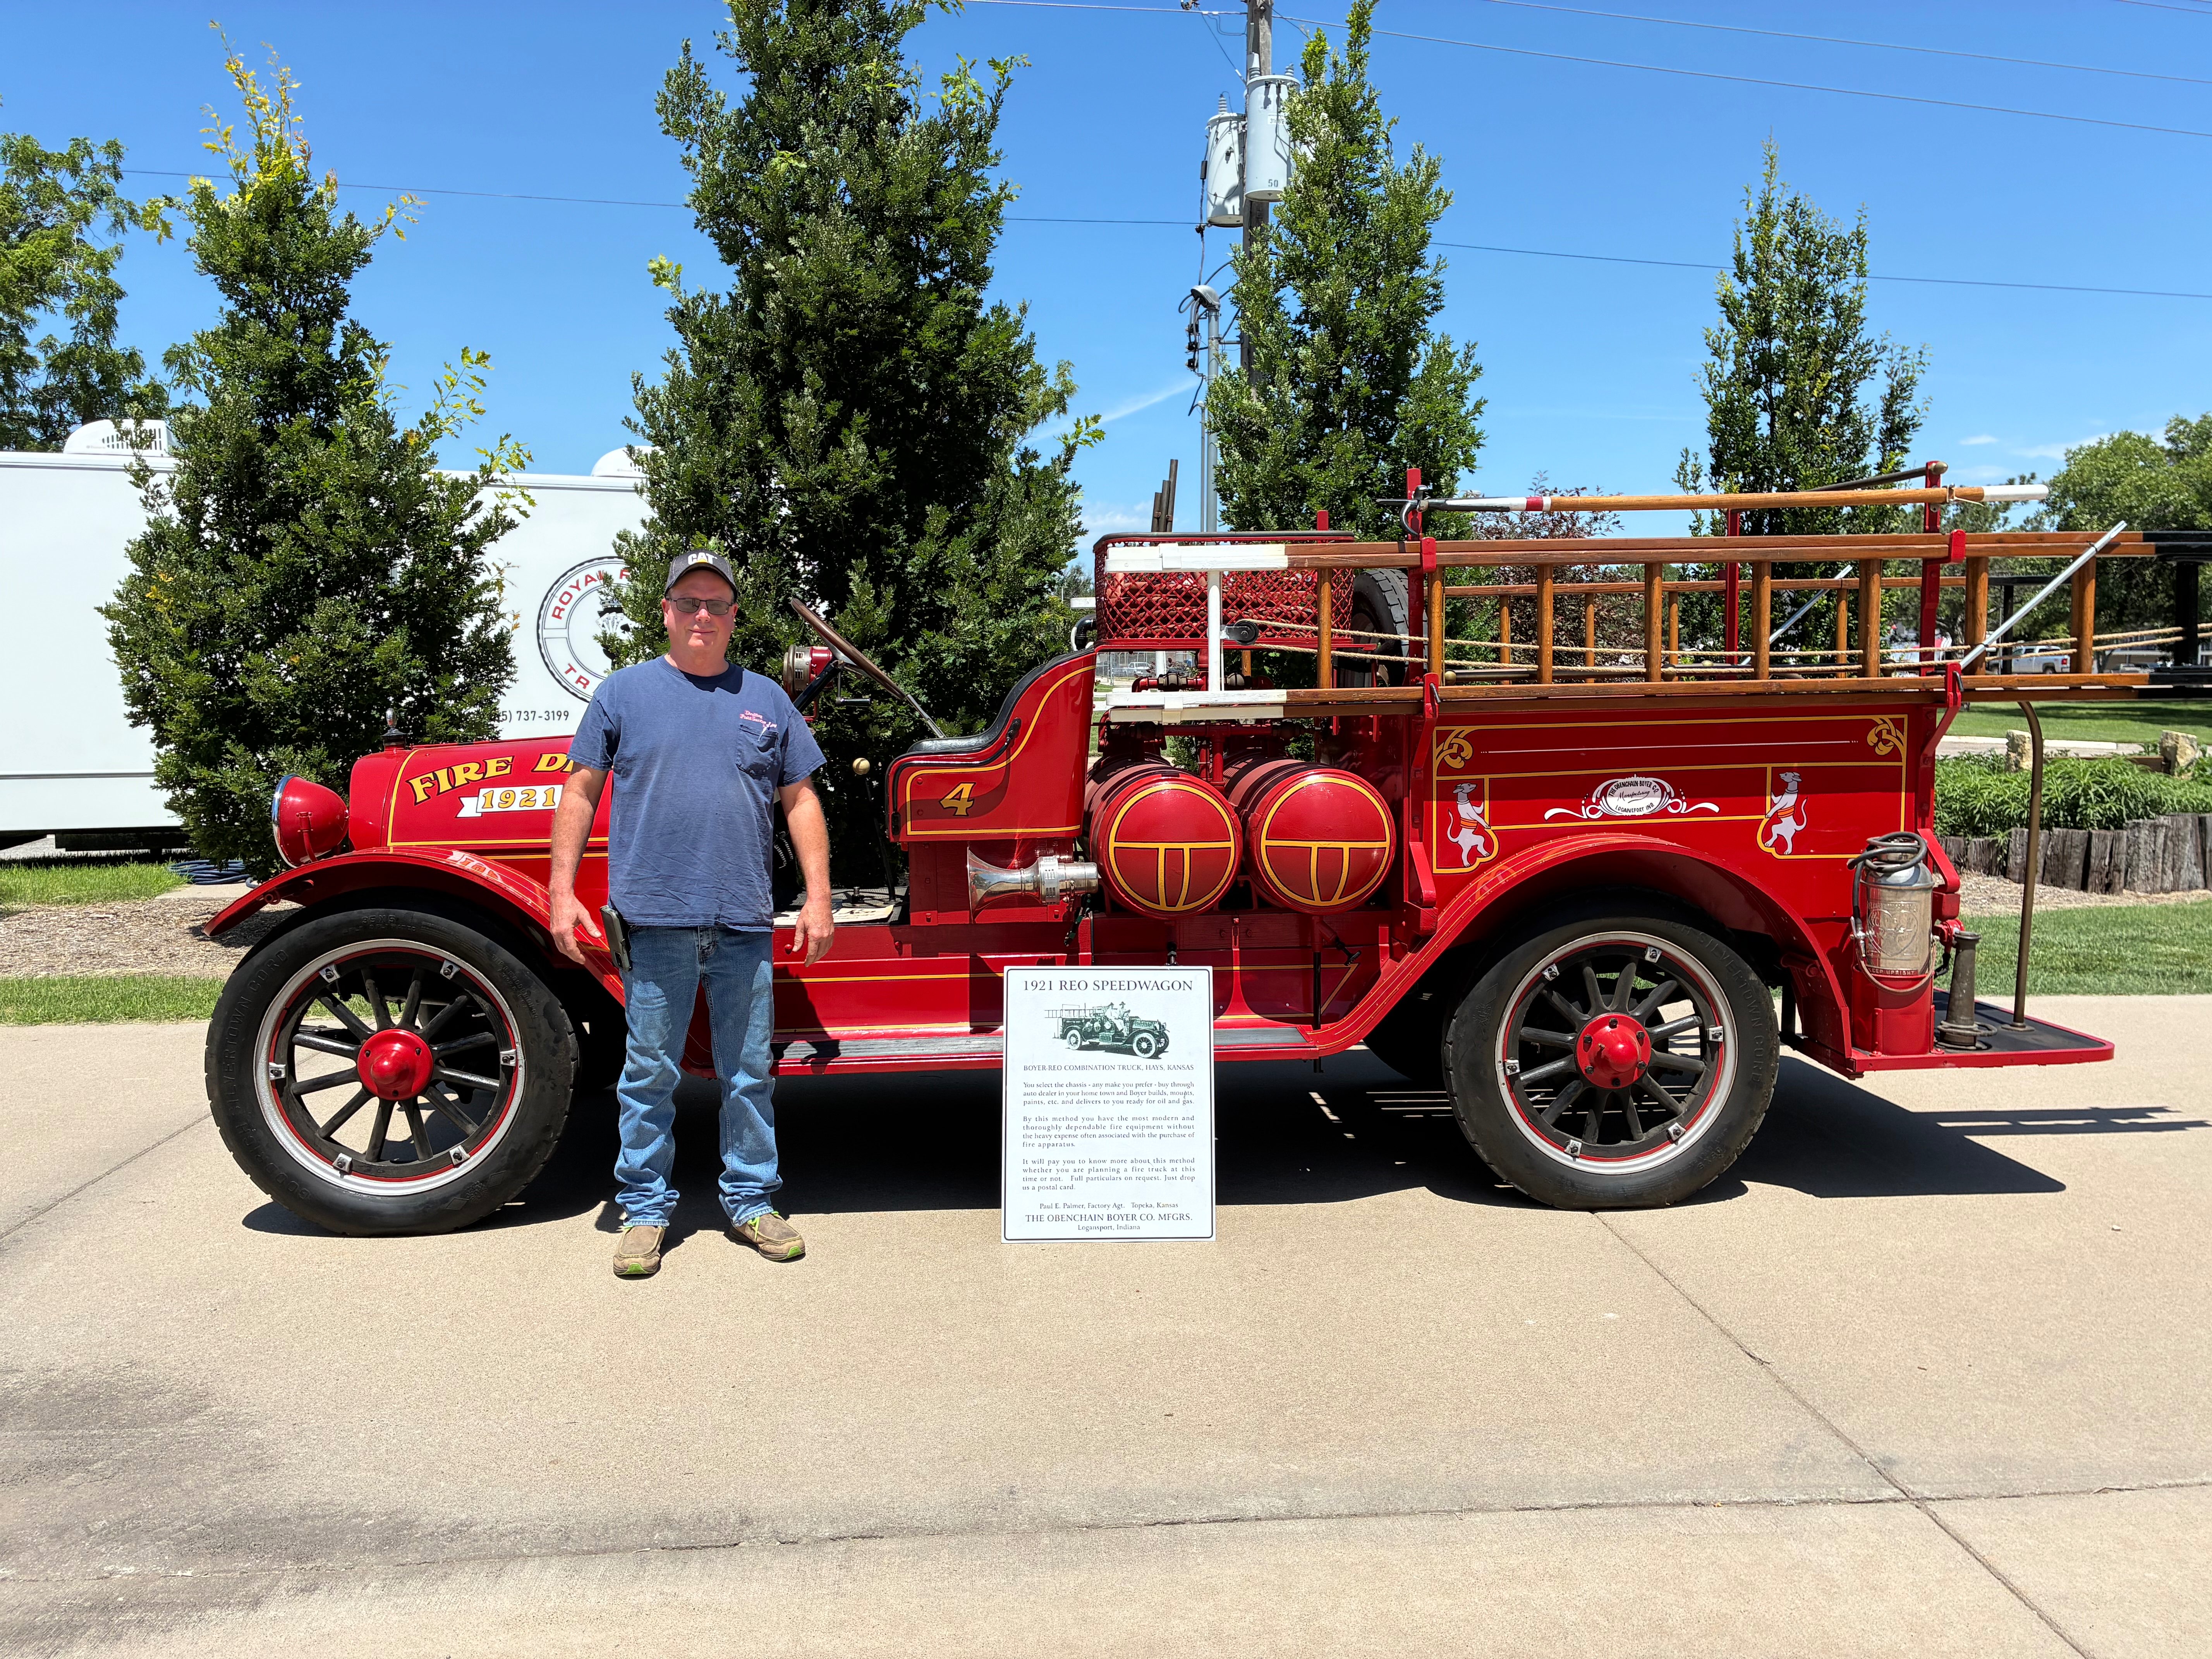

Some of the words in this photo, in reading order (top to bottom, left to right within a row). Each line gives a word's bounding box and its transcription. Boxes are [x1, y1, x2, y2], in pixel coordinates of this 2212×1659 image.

[1268, 179, 1278, 188] 50
[688, 552, 714, 565] CAT
[516, 710, 569, 721] 737-3199
[406, 756, 515, 806] FIRE
[531, 753, 574, 773] D
[481, 787, 556, 809] 1921
[939, 781, 977, 816] 4
[1615, 805, 1644, 813] LOGANSPORT
[247, 950, 289, 993] CORD
[1024, 980, 1053, 991] 1921
[1059, 980, 1088, 991] REO
[1092, 980, 1192, 991] SPEEDWAGON
[1135, 1081, 1153, 1089] prefer
[1126, 1098, 1144, 1106] ready
[1023, 1124, 1062, 1132] thoroughly
[1065, 1123, 1106, 1132] dependable
[1034, 1132, 1052, 1140] heavy
[1159, 1132, 1186, 1140] purchase
[1088, 1166, 1120, 1174] planning
[1085, 1175, 1121, 1183] particulars
[1180, 1174, 1195, 1182] drop
[1037, 1184, 1057, 1192] postal
[1087, 1202, 1111, 1211] Factory
[1112, 1202, 1125, 1210] Agt.
[1130, 1202, 1154, 1210] Topeka,
[1025, 1214, 1044, 1222] THE
[1047, 1214, 1104, 1222] OBENCHAIN
[1107, 1213, 1137, 1221] BOYER
[1139, 1213, 1155, 1221] CO.
[1078, 1224, 1114, 1232] Logansport,
